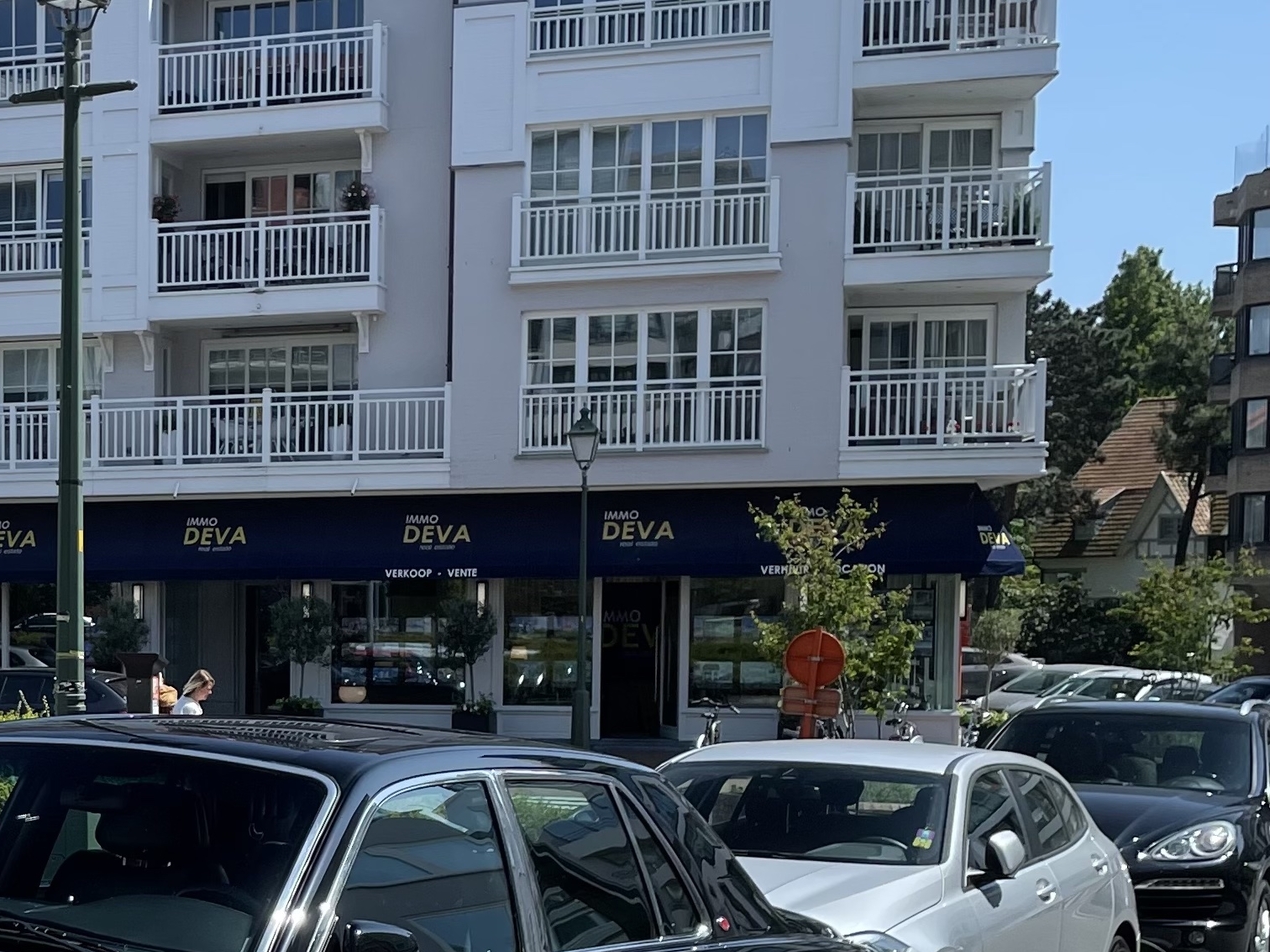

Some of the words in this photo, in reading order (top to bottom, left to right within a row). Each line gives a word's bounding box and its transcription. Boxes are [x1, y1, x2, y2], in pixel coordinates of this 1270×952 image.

[186, 517, 218, 526] IMMO
[406, 514, 439, 523] IMMO
[604, 510, 639, 520] IMMO
[183, 526, 246, 545] DEVA
[402, 524, 471, 543] DEVA
[602, 521, 675, 540] DEVA
[980, 532, 1011, 545] DEVA
[385, 569, 432, 578] VERKOOP
[447, 568, 478, 577] VENTE
[602, 609, 641, 623] MMO
